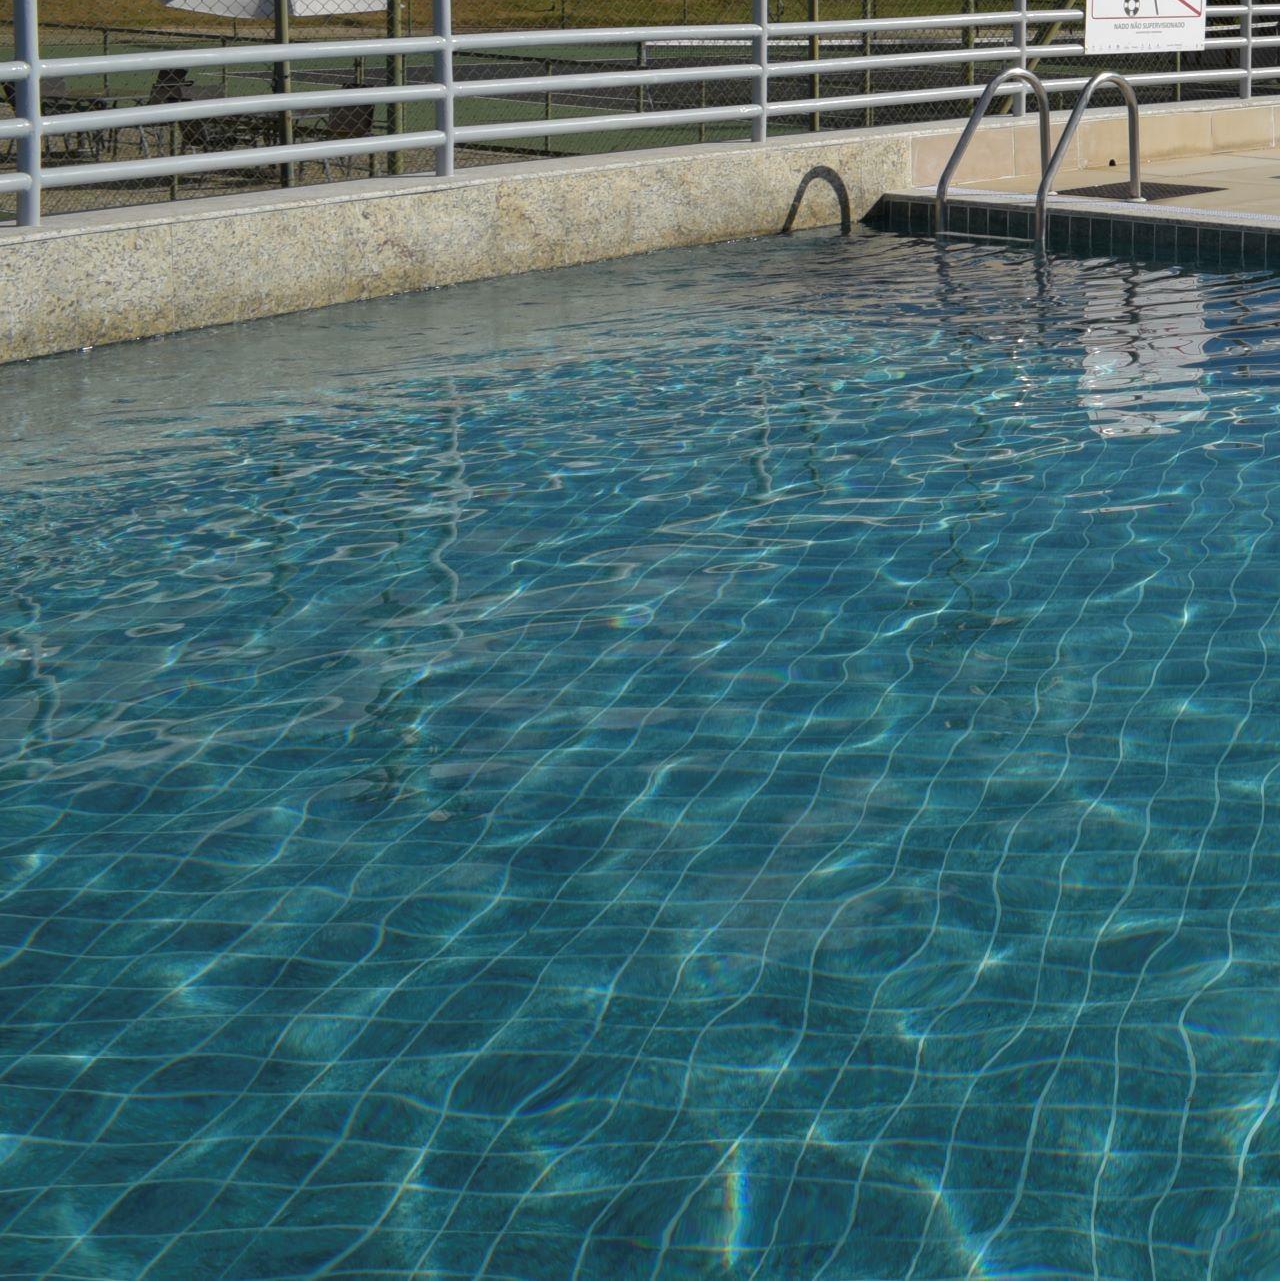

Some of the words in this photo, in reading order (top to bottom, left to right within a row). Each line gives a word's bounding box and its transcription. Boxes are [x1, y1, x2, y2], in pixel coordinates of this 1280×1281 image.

[1114, 22, 1129, 30] NADO
[1130, 21, 1142, 30] NÃO
[1142, 21, 1185, 29] SUPERVISIONADO
